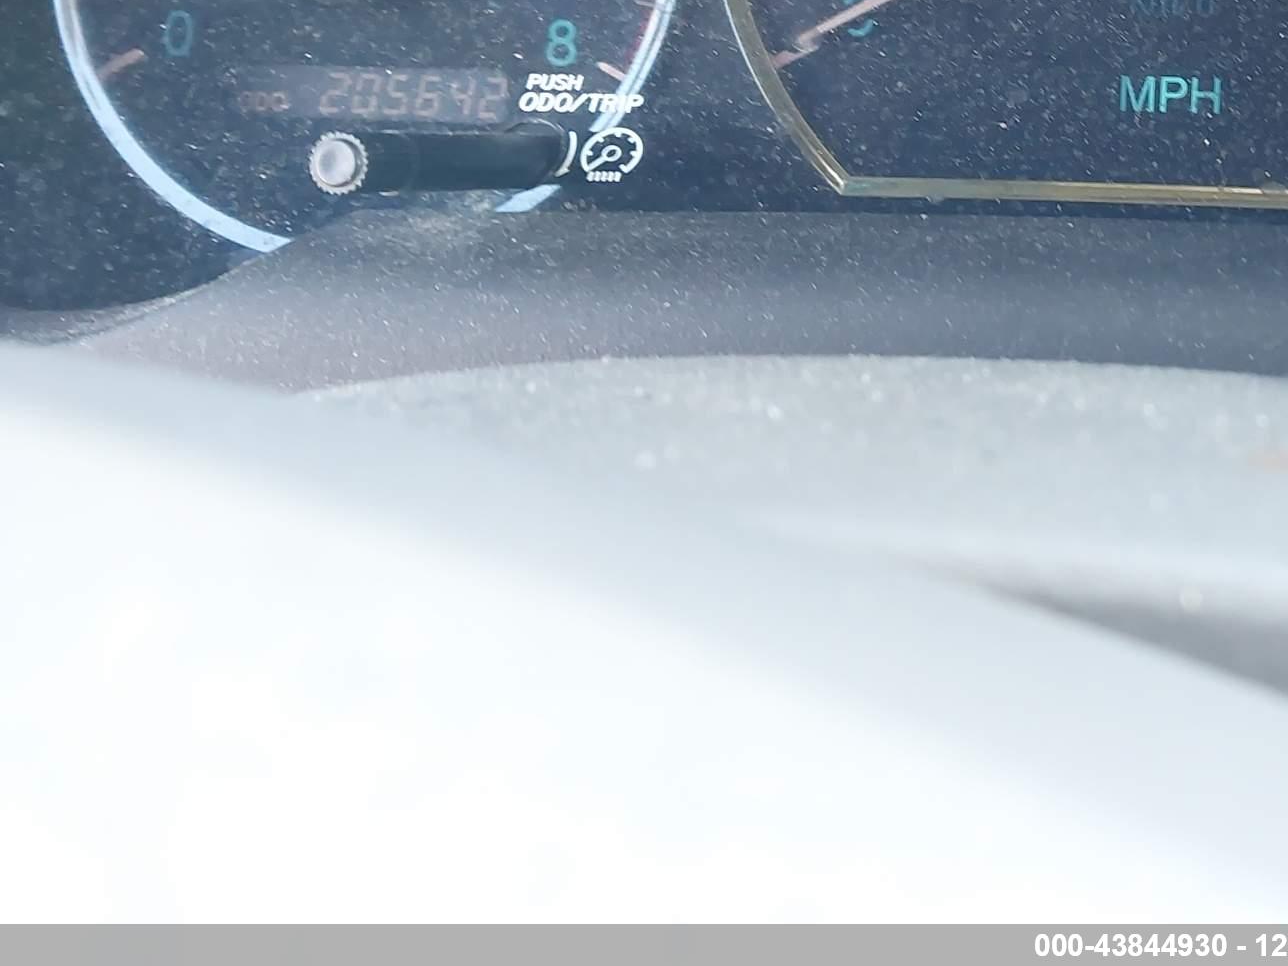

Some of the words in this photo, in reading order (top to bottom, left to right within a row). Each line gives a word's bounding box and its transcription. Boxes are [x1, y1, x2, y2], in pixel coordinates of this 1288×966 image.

[162, 11, 194, 57] 0
[546, 20, 577, 66] 8
[318, 73, 508, 120] 205642
[519, 93, 645, 114] ODO/TRIP
[525, 74, 584, 92] PUSH
[1120, 75, 1222, 114] MPH
